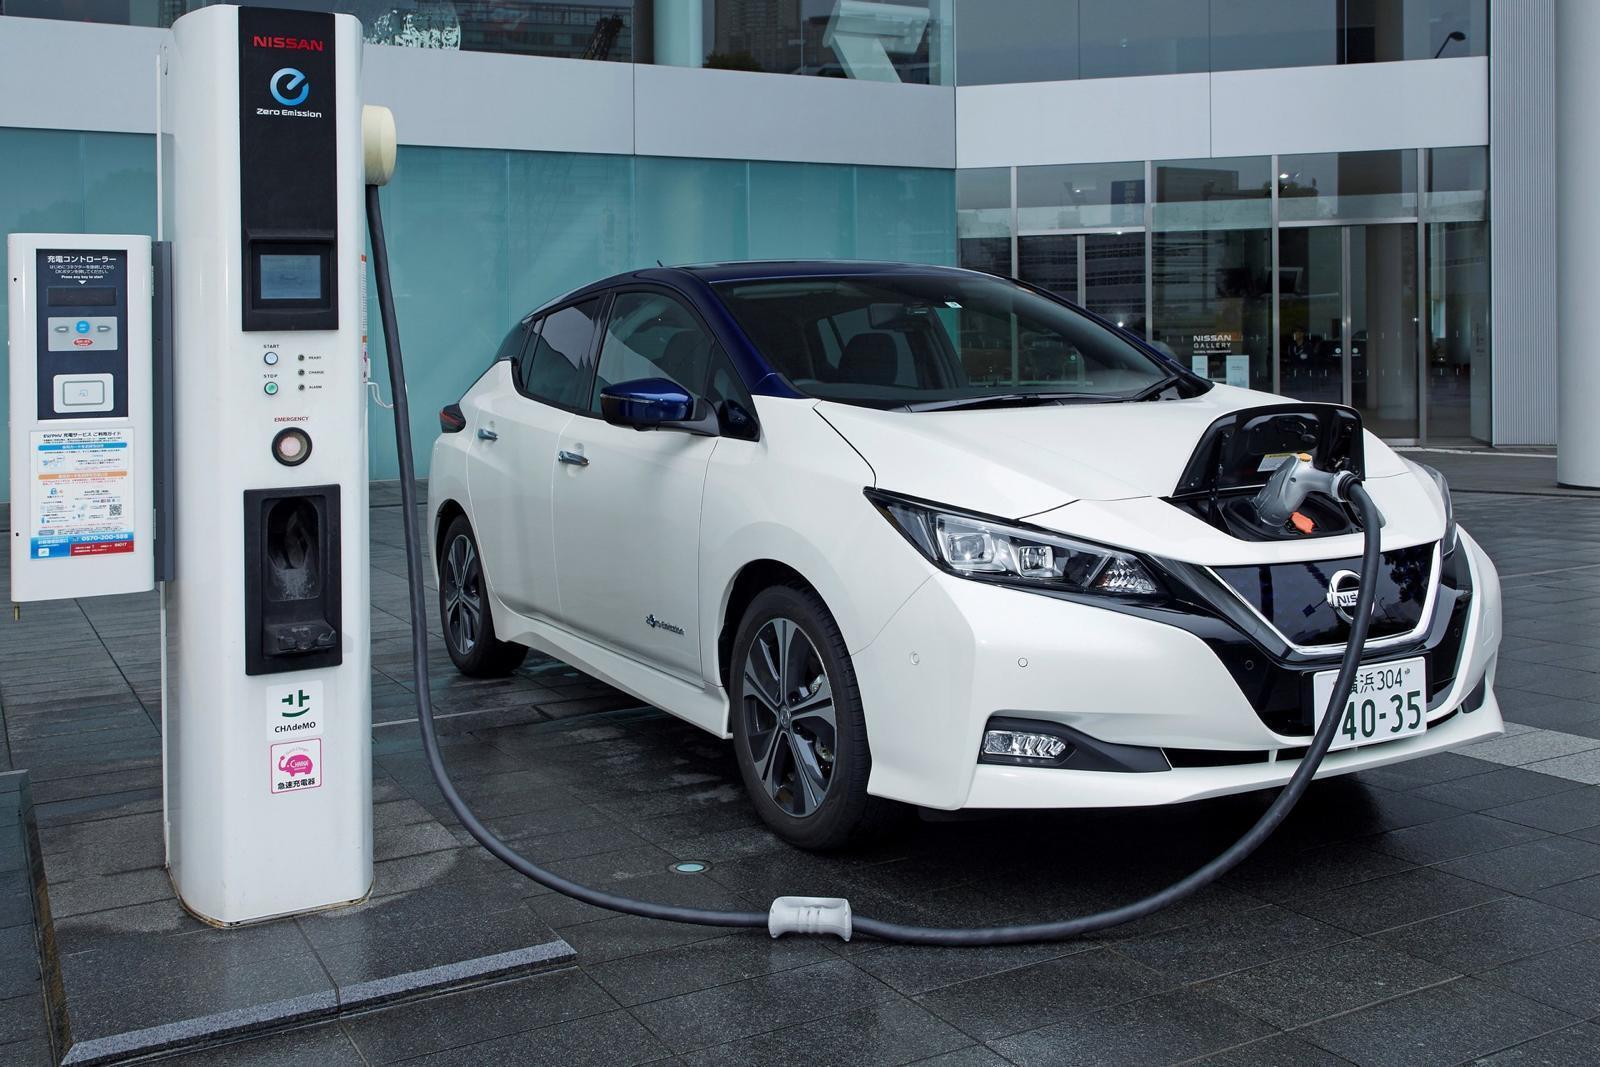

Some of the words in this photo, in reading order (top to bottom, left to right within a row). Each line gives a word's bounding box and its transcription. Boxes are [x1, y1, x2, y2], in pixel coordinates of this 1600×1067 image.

[253, 35, 324, 52] NISSAN
[256, 107, 280, 116] Zero
[281, 109, 322, 118] Emission
[47, 255, 117, 263] 充電コントローラー
[1193, 334, 1232, 342] NISSAN
[1376, 667, 1403, 691] 304
[1342, 690, 1421, 741] 40-35
[277, 777, 316, 790] 急速充電器
